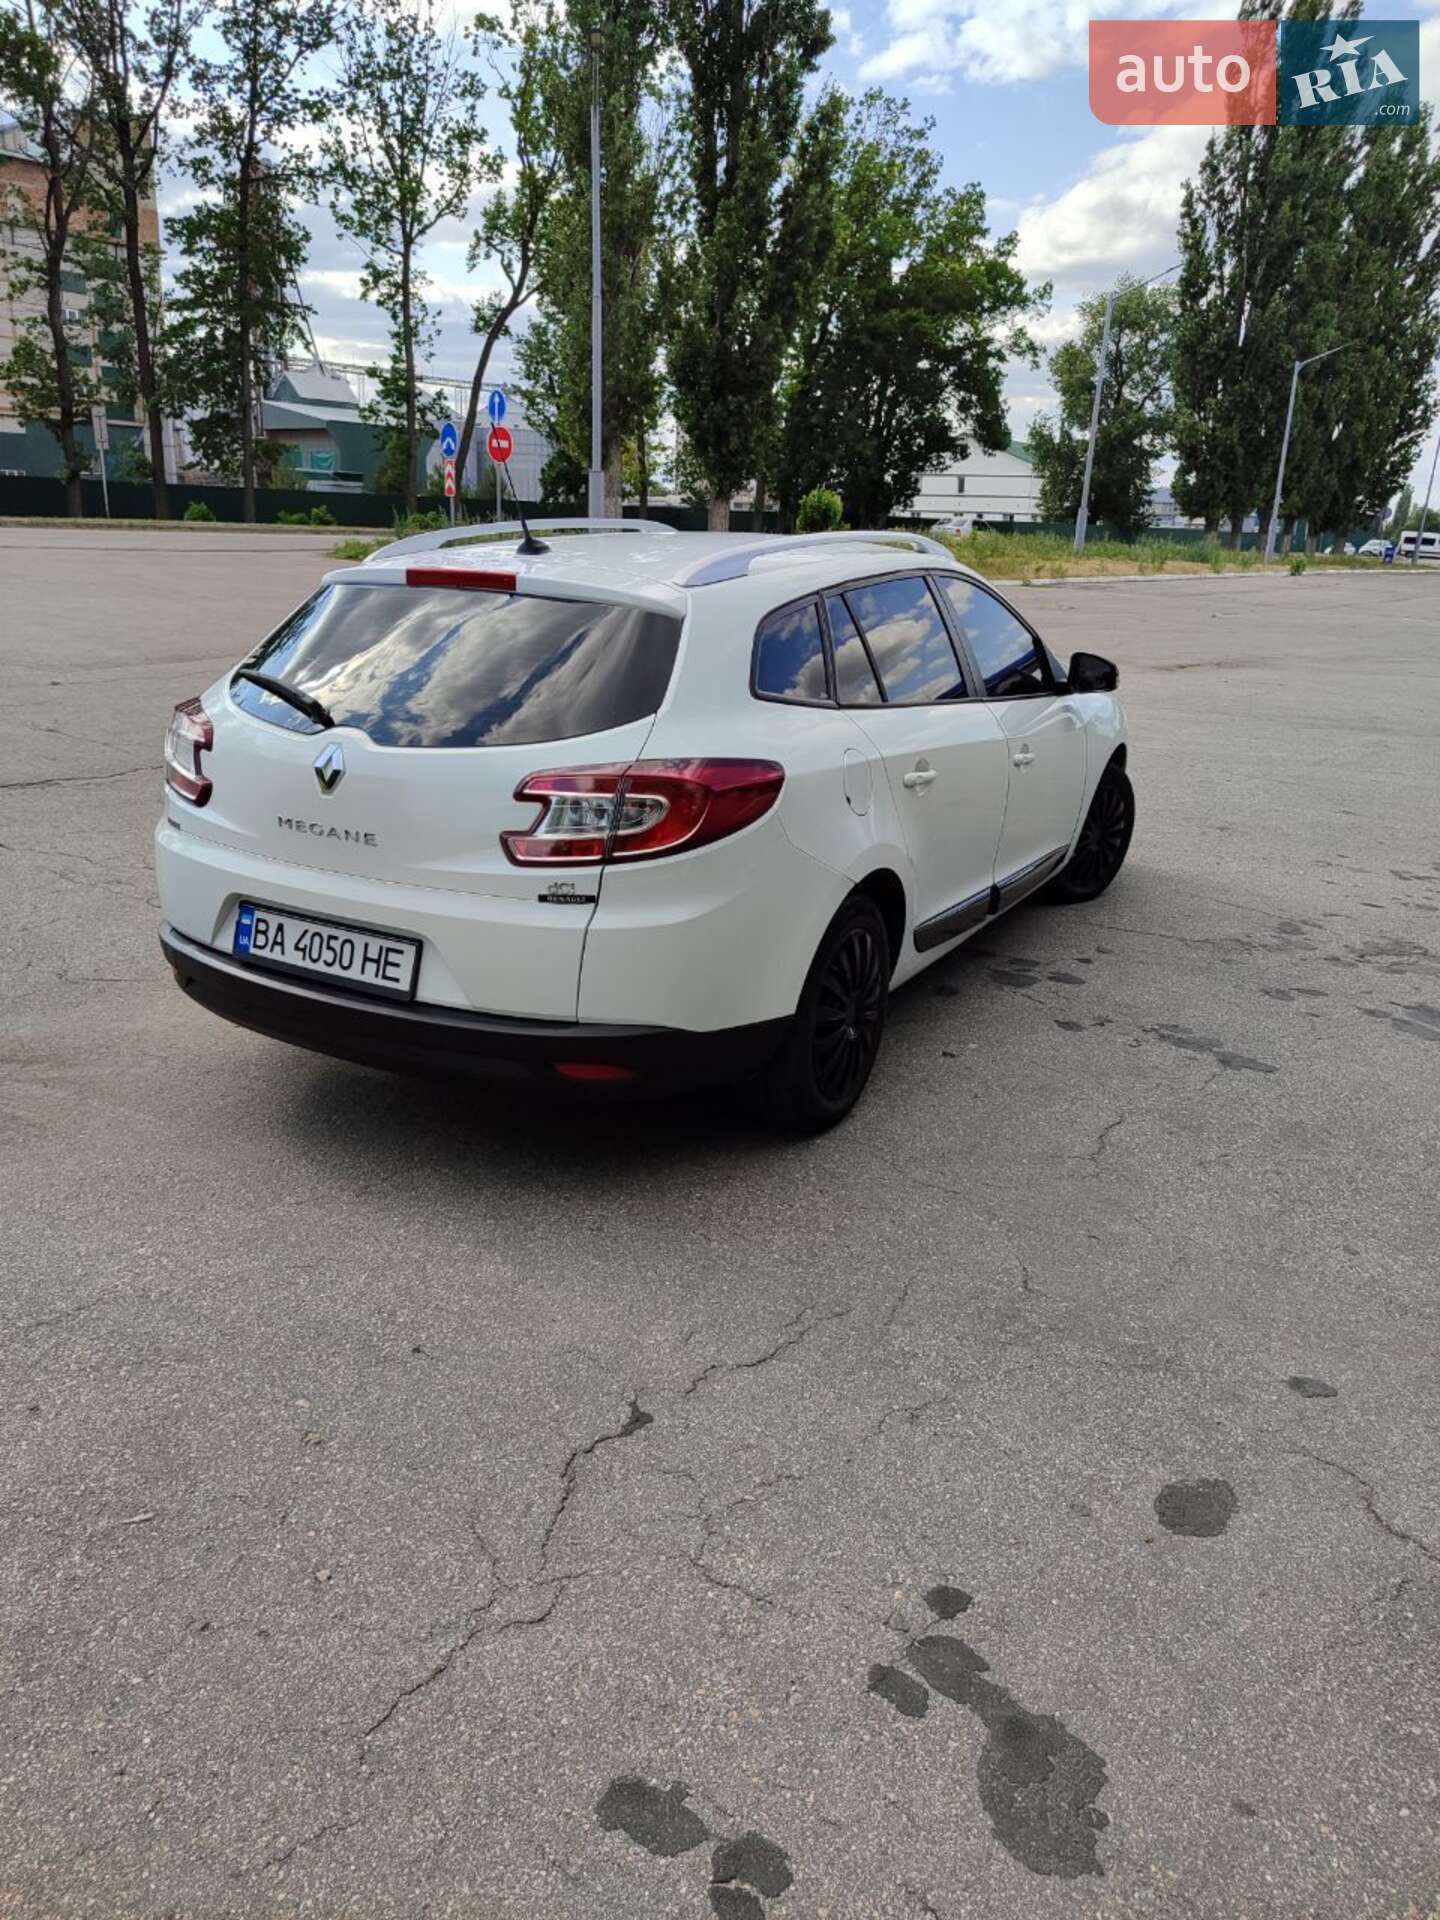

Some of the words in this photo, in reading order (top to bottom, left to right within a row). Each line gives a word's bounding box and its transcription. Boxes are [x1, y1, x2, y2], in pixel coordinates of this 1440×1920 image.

[277, 815, 378, 847] MEGANE
[252, 917, 285, 956] BA
[294, 928, 355, 971] 4050
[361, 942, 404, 983] HE
